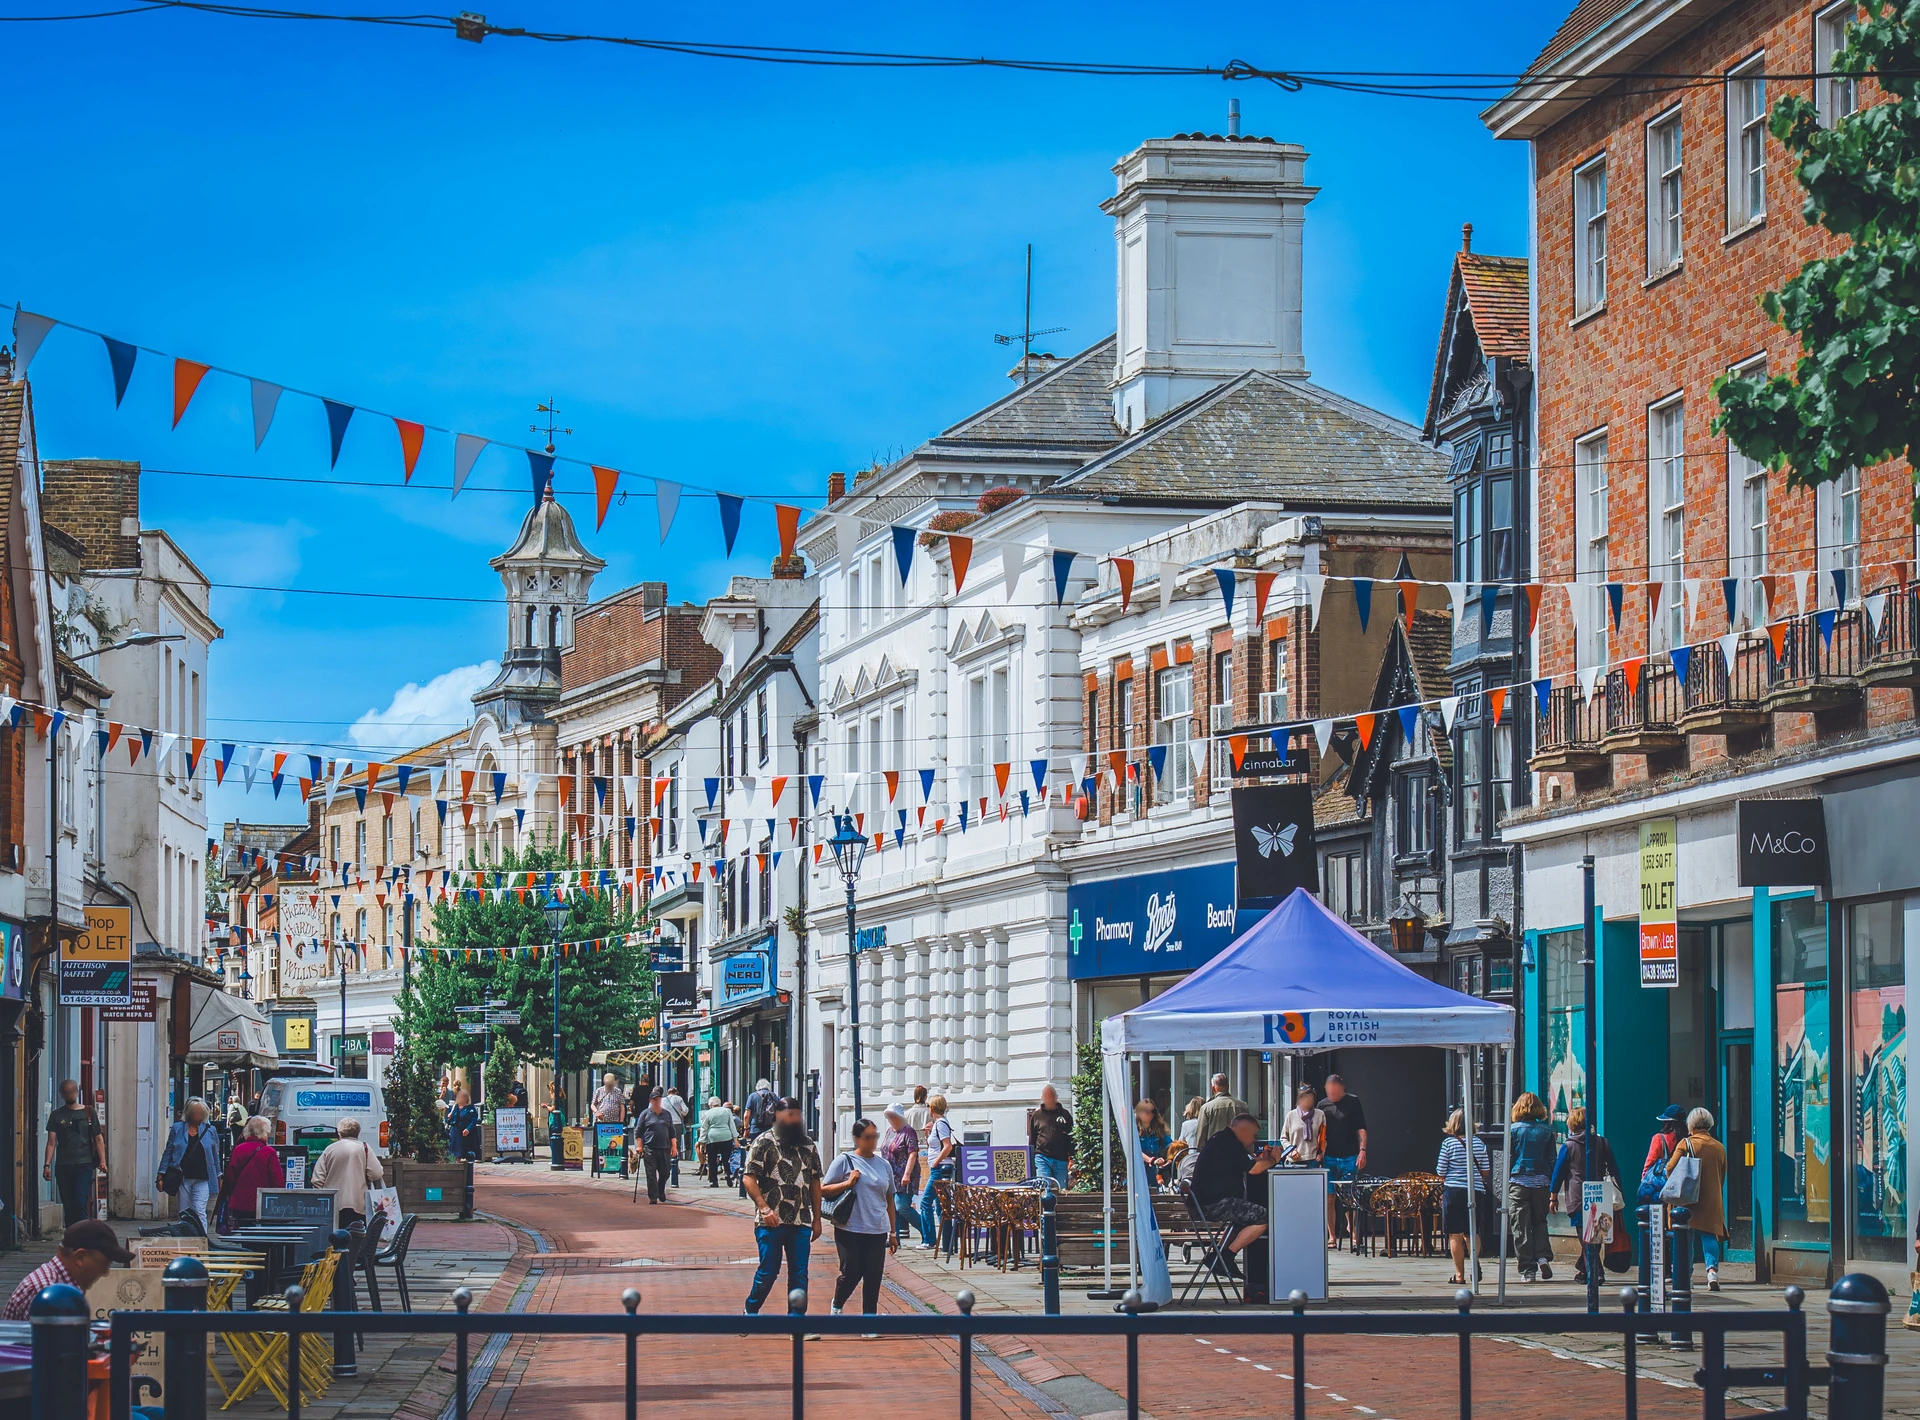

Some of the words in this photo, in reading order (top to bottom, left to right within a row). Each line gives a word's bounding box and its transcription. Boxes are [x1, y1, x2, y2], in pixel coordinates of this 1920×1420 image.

[1244, 758, 1296, 770] cinnabar
[1646, 832, 1668, 848] APPROX
[1750, 831, 1816, 854] M&Co
[1656, 854, 1663, 868] SQ
[1664, 853, 1672, 868] FT
[1641, 883, 1652, 910] TO
[1655, 882, 1674, 909] LET
[1096, 916, 1133, 945] Pharmacy
[1143, 891, 1176, 953] Boots
[1207, 903, 1236, 934] Beauty
[77, 935, 90, 950] O
[96, 936, 126, 950] LET
[1642, 932, 1674, 950] Brown&Lee
[284, 959, 318, 980] WILLIS
[666, 998, 692, 1006] Clarks
[1328, 1011, 1368, 1019] ROYAL
[1329, 1022, 1379, 1030] BRITISH
[1329, 1033, 1377, 1042] LEGION
[1584, 1196, 1602, 1211] gum
